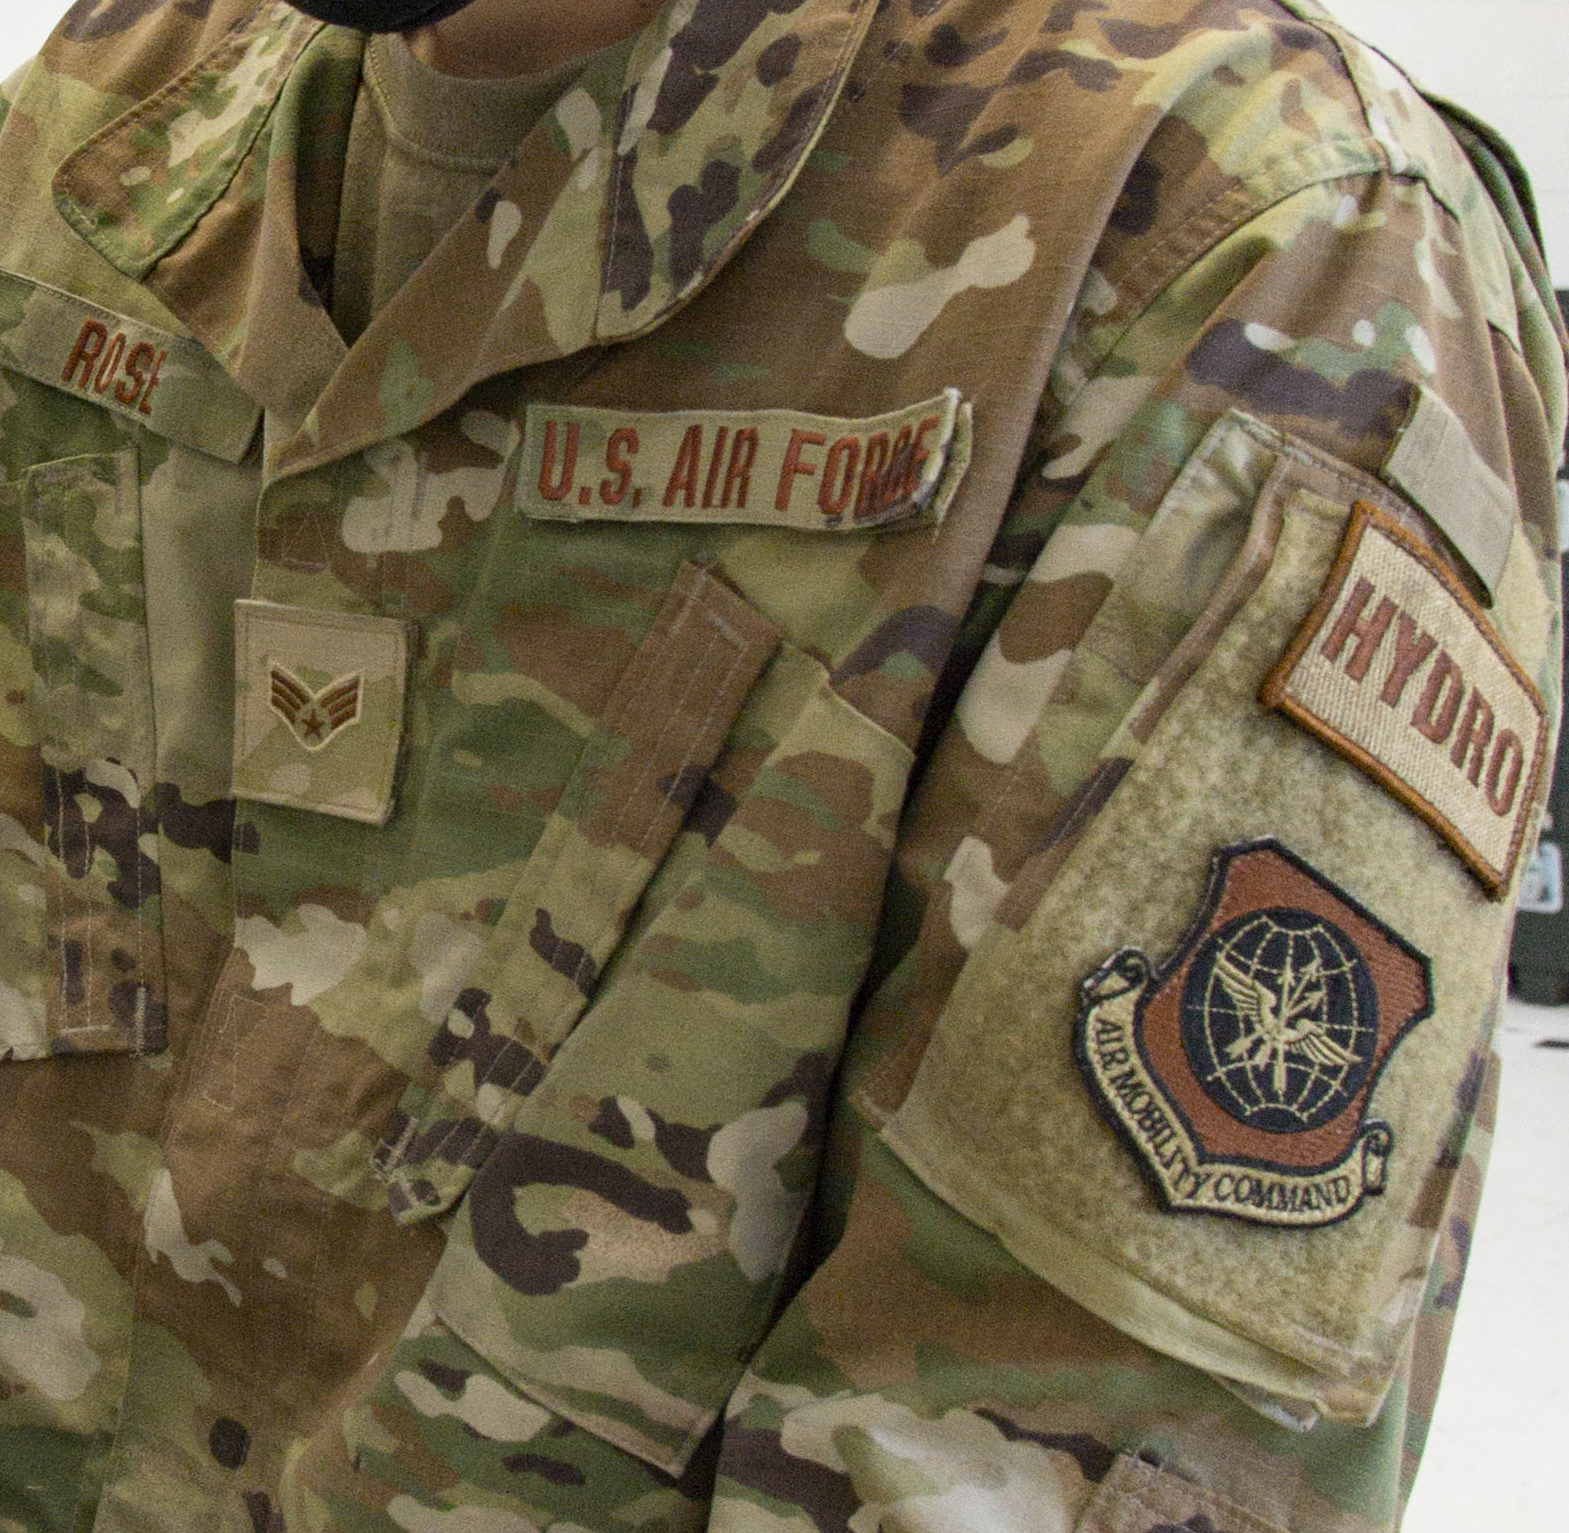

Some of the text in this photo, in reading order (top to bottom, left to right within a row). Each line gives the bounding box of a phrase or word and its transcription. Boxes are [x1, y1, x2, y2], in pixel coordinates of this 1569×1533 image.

[537, 416, 942, 520] U.S. AIR FORCE
[1320, 576, 1524, 817] HYDRO
[1095, 1017, 1351, 1212] AIR MOBILITY COMMAND
